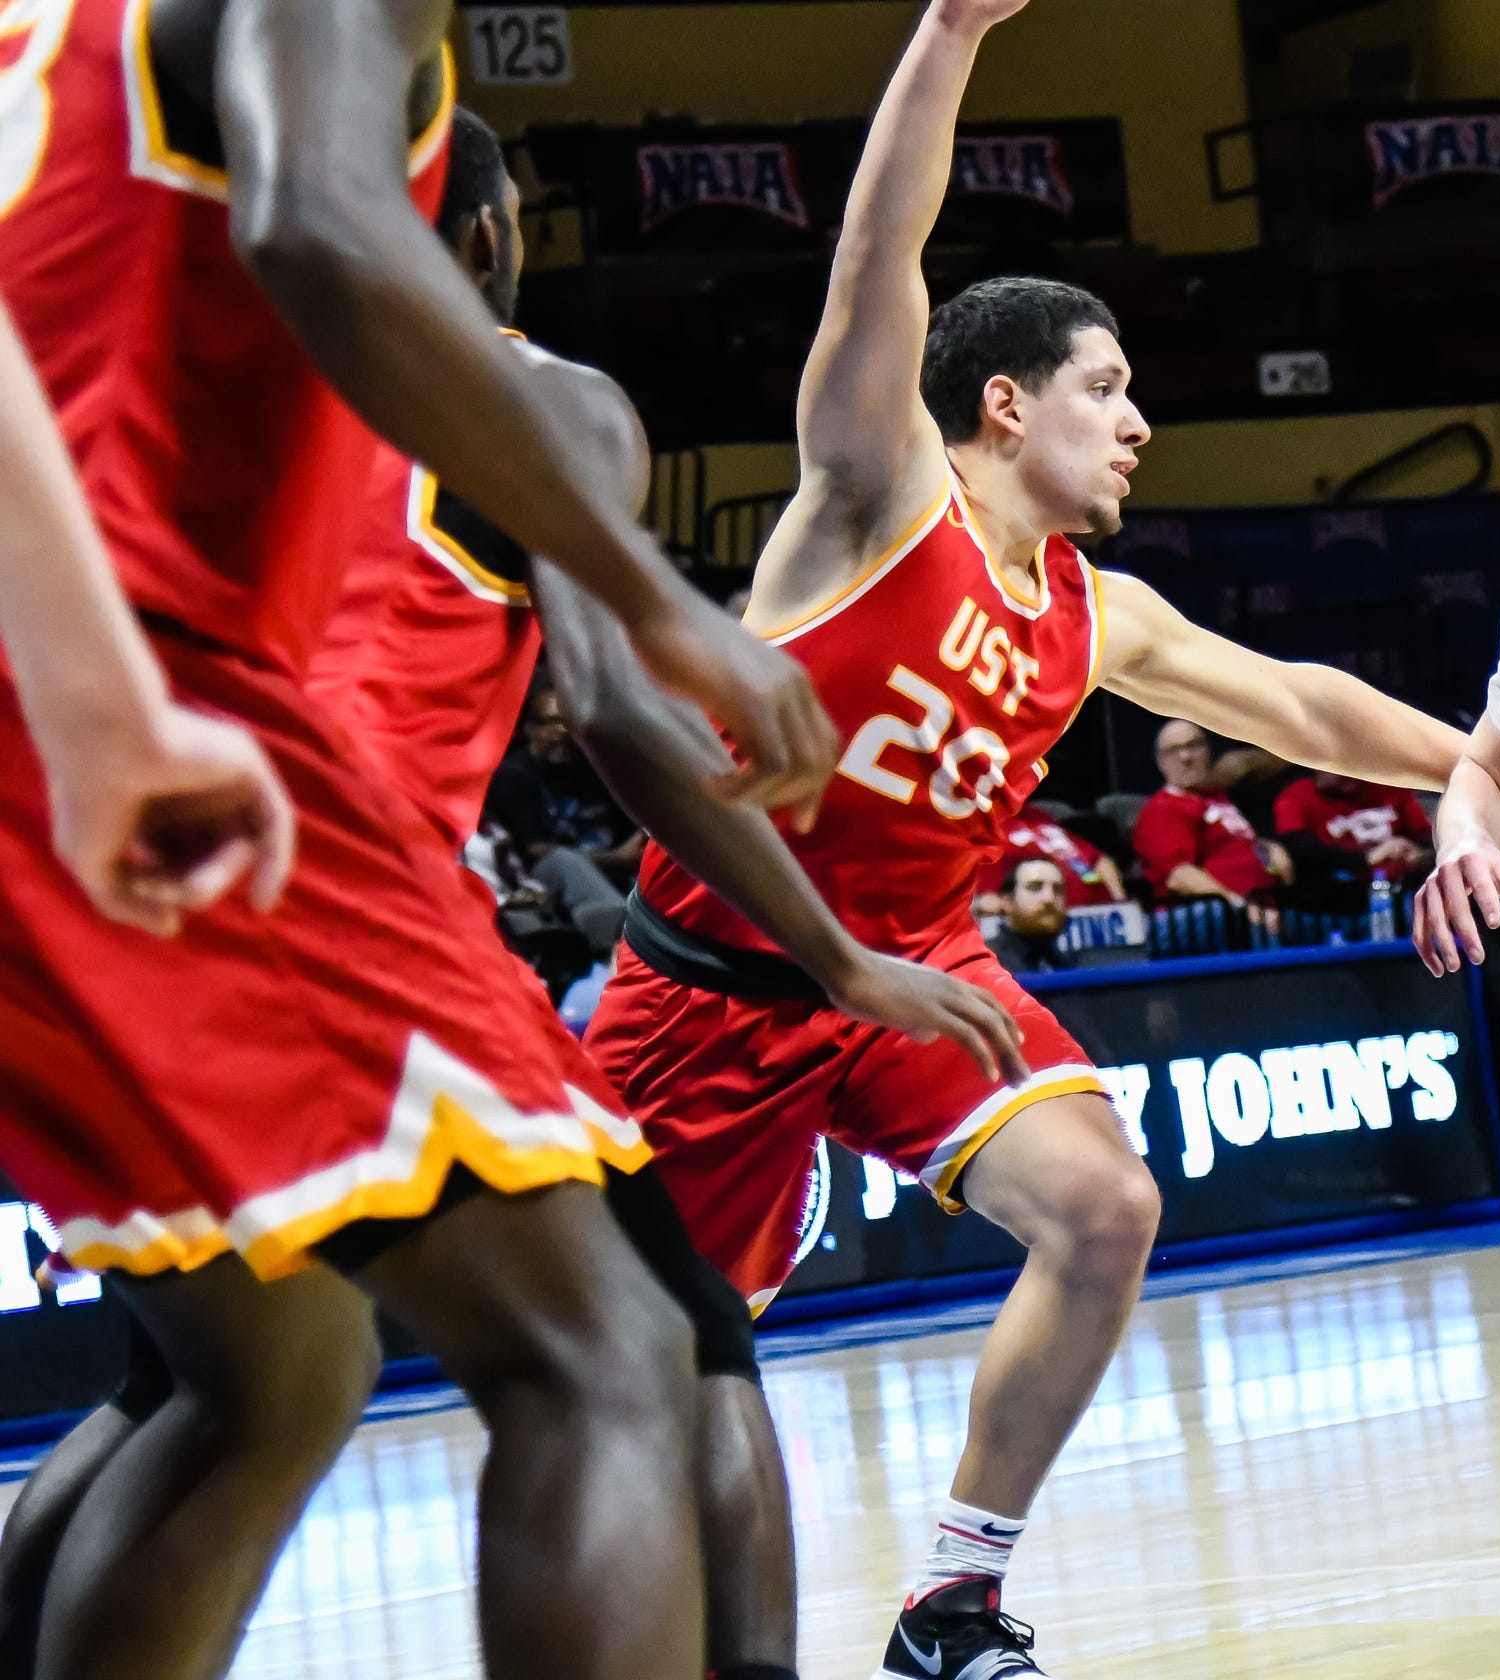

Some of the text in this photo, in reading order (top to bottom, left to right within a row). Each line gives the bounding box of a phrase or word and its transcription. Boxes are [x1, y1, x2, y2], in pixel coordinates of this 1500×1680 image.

[477, 15, 565, 77] 125
[640, 147, 805, 224] NAIA
[953, 138, 1069, 210] AIA
[939, 596, 1040, 717] UST
[835, 664, 1011, 820] 20
[1169, 1030, 1458, 1178] JOHN'S
